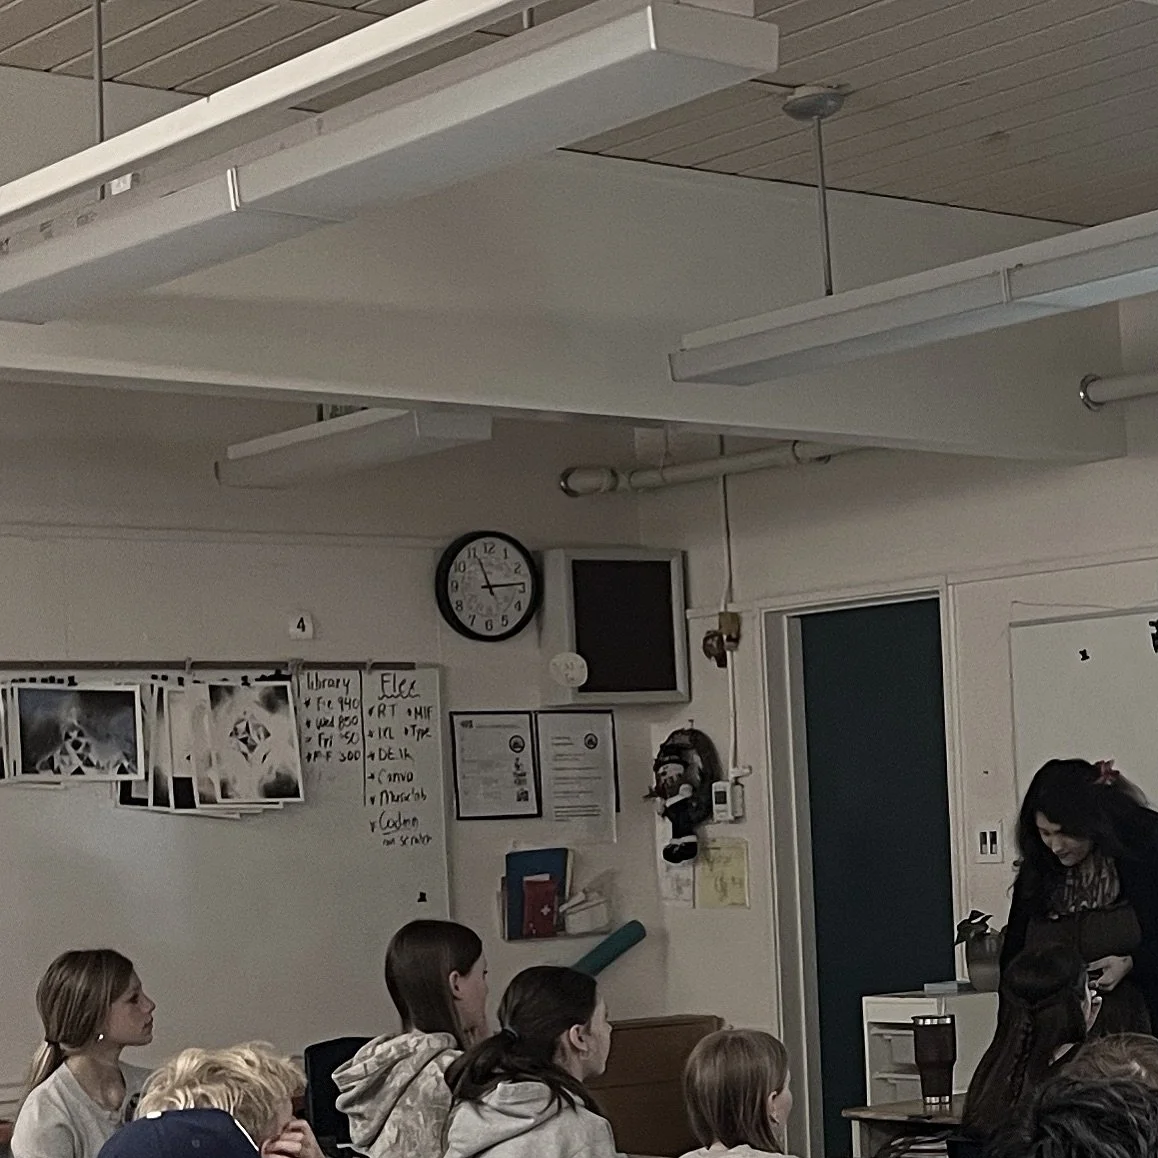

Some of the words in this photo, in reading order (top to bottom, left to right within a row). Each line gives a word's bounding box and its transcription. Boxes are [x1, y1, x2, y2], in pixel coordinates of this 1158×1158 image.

[484, 542, 496, 554] 12
[450, 580, 458, 592] 9
[296, 616, 306, 632] 4
